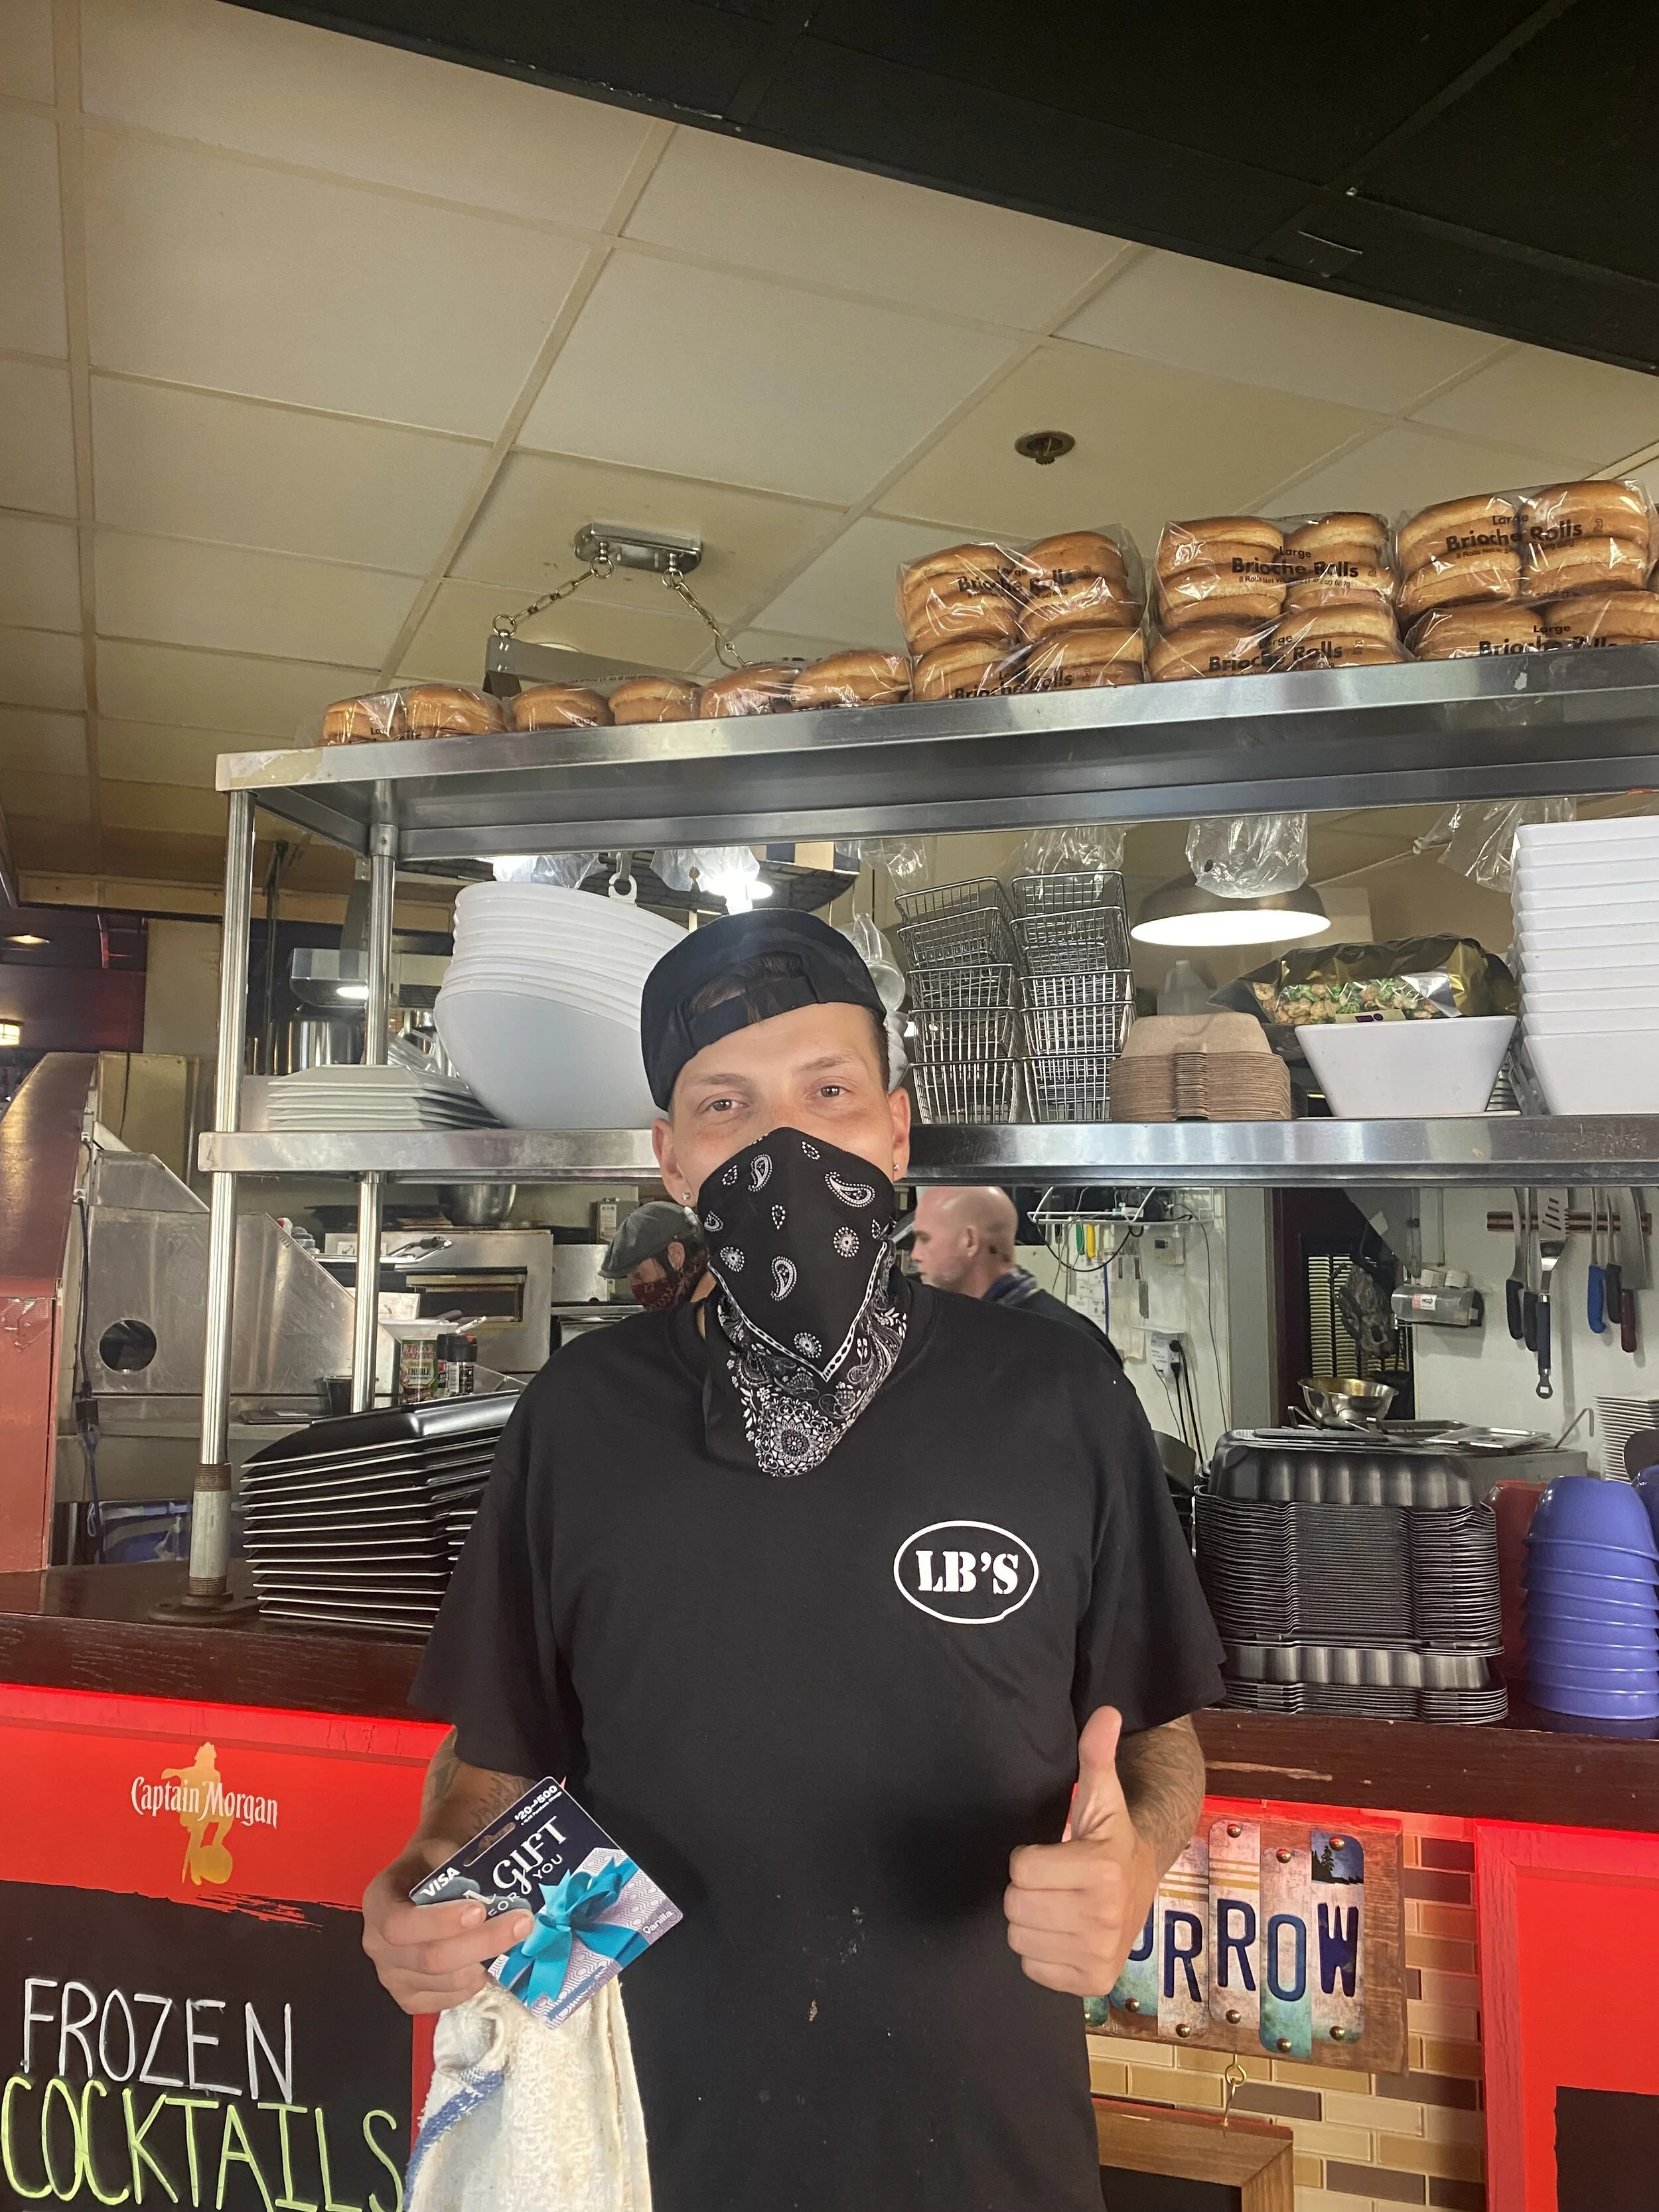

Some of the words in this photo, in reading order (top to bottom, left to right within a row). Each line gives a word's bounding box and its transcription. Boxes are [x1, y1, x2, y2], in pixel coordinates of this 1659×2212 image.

[1492, 514, 1529, 526] Large
[1445, 529, 1522, 552] Brioche
[1530, 519, 1583, 540] Rolls
[1232, 557, 1306, 574] Brioche
[1279, 546, 1311, 559] Large
[1533, 625, 1571, 634] Large
[1293, 641, 1342, 662] Rolls
[915, 1550, 1019, 1595] LB'S
[131, 1776, 200, 1817] Captain
[197, 1781, 277, 1830] Morgan
[493, 1816, 566, 1895] GIFT
[532, 1854, 563, 1880] YOU
[419, 1867, 461, 1897] VISA
[642, 1910, 674, 1935] Vanilla
[23, 1977, 293, 2103] FROZEN
[1, 2075, 403, 2212] COCKTAILS
